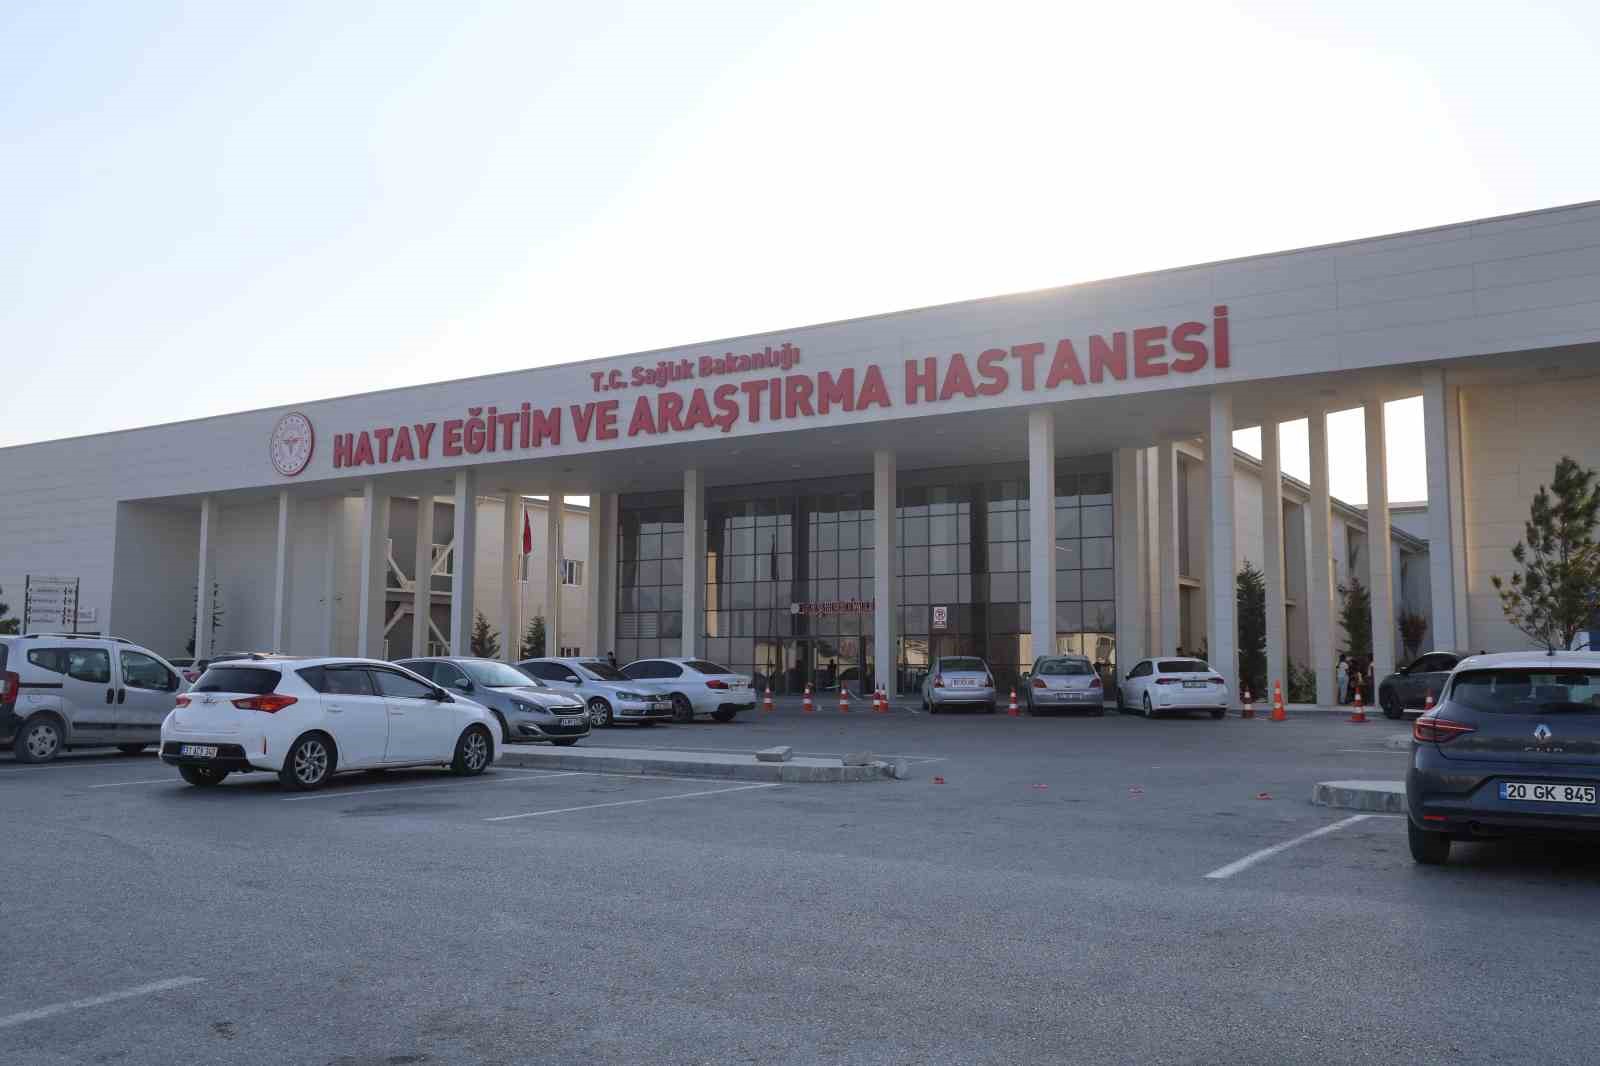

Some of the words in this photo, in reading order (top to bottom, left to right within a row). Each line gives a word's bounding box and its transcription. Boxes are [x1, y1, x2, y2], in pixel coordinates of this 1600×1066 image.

[332, 422, 436, 468] HATAY
[442, 401, 563, 457] EĞİTİM
[570, 399, 620, 442] VE
[627, 365, 891, 438] ARAŞTIRMA
[905, 305, 1231, 405] HASTANESİ
[590, 371, 628, 392] T.C.
[631, 358, 695, 388] Sağlık
[698, 342, 801, 378] Bakanlığı
[1507, 784, 1526, 799] 20
[1533, 785, 1556, 800] GK
[1564, 787, 1594, 802] 845
